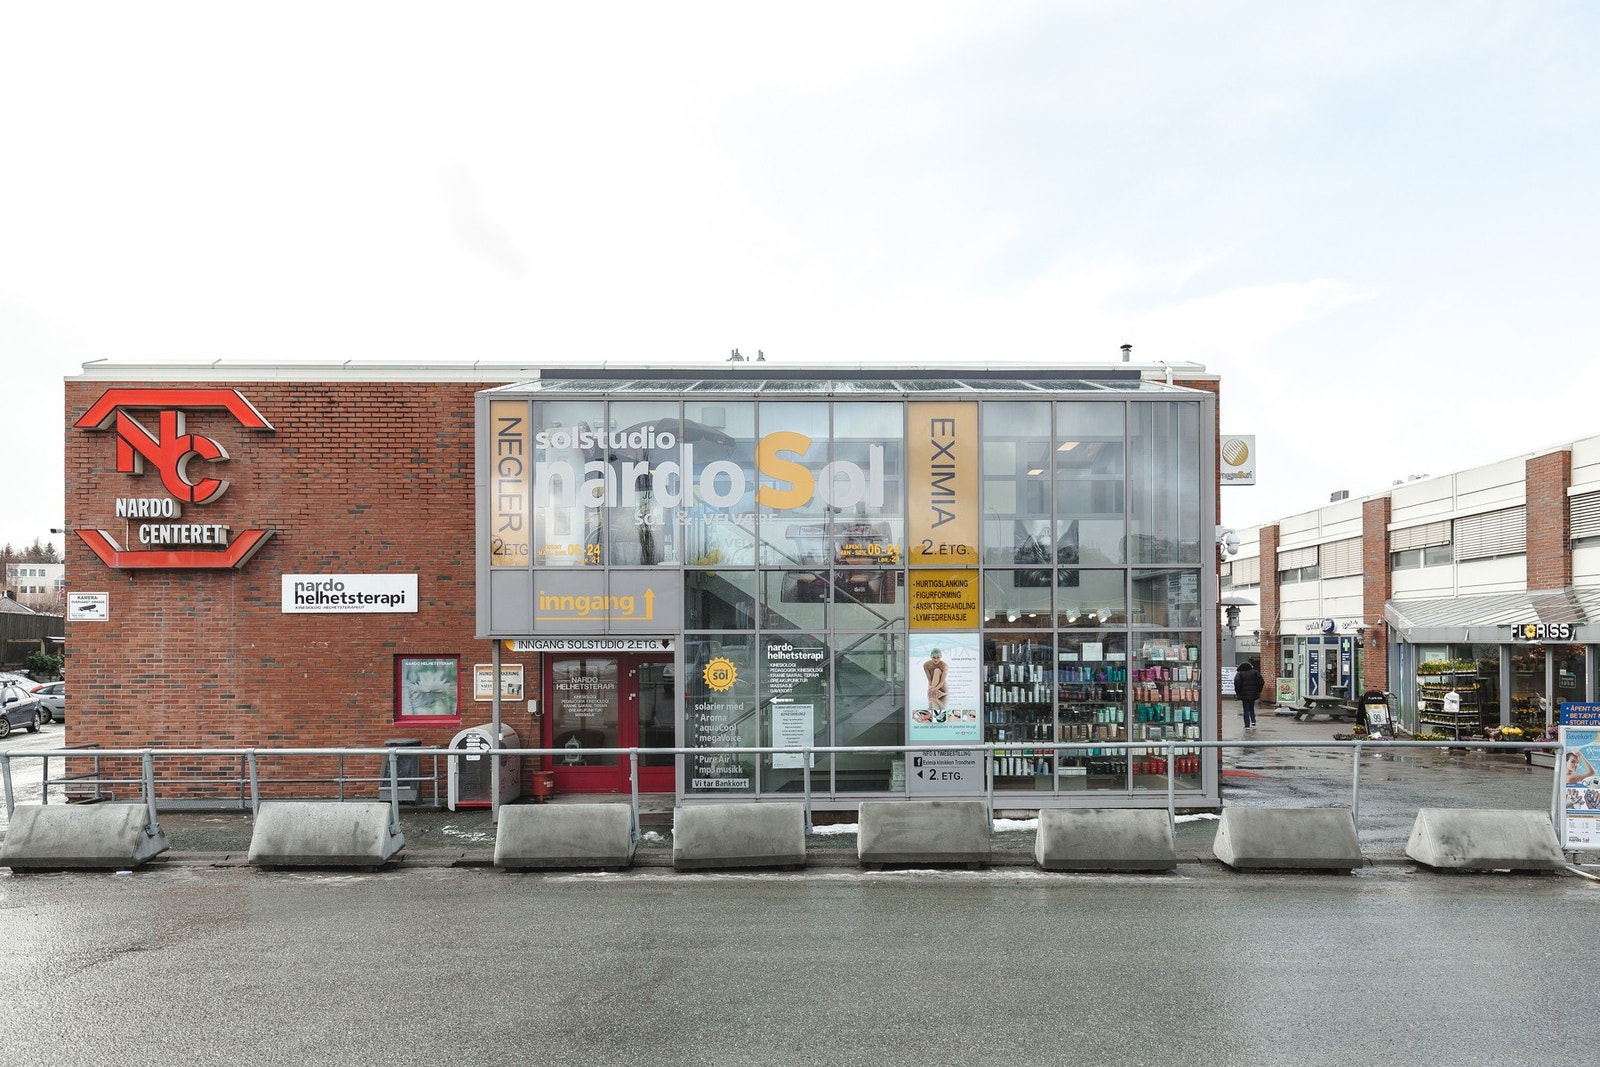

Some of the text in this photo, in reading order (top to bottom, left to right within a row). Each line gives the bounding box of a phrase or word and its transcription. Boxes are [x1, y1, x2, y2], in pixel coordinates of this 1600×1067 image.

[535, 426, 677, 450] solstudio
[498, 418, 523, 533] NEGLER
[930, 418, 956, 529] EXIMIA
[115, 497, 177, 518] NARDO
[634, 512, 665, 526] SOL
[676, 510, 692, 526] &
[138, 523, 224, 544] CENTERET
[294, 578, 345, 592] nardo
[294, 590, 405, 607] helhetsterapi
[539, 590, 635, 616] inngang
[518, 640, 565, 649] INNGANG
[567, 640, 625, 649] SOLSTUDIO
[767, 643, 793, 651] nardo
[767, 651, 824, 661] helhetsterapi
[712, 669, 729, 680] sol
[694, 701, 744, 711] solarier med
[700, 713, 727, 721] Aroma
[699, 723, 737, 734] aquaCool
[699, 734, 742, 744] megaVoice
[1566, 733, 1593, 741] Gavekort
[718, 755, 731, 763] Air
[699, 764, 743, 776] mp3 musikk
